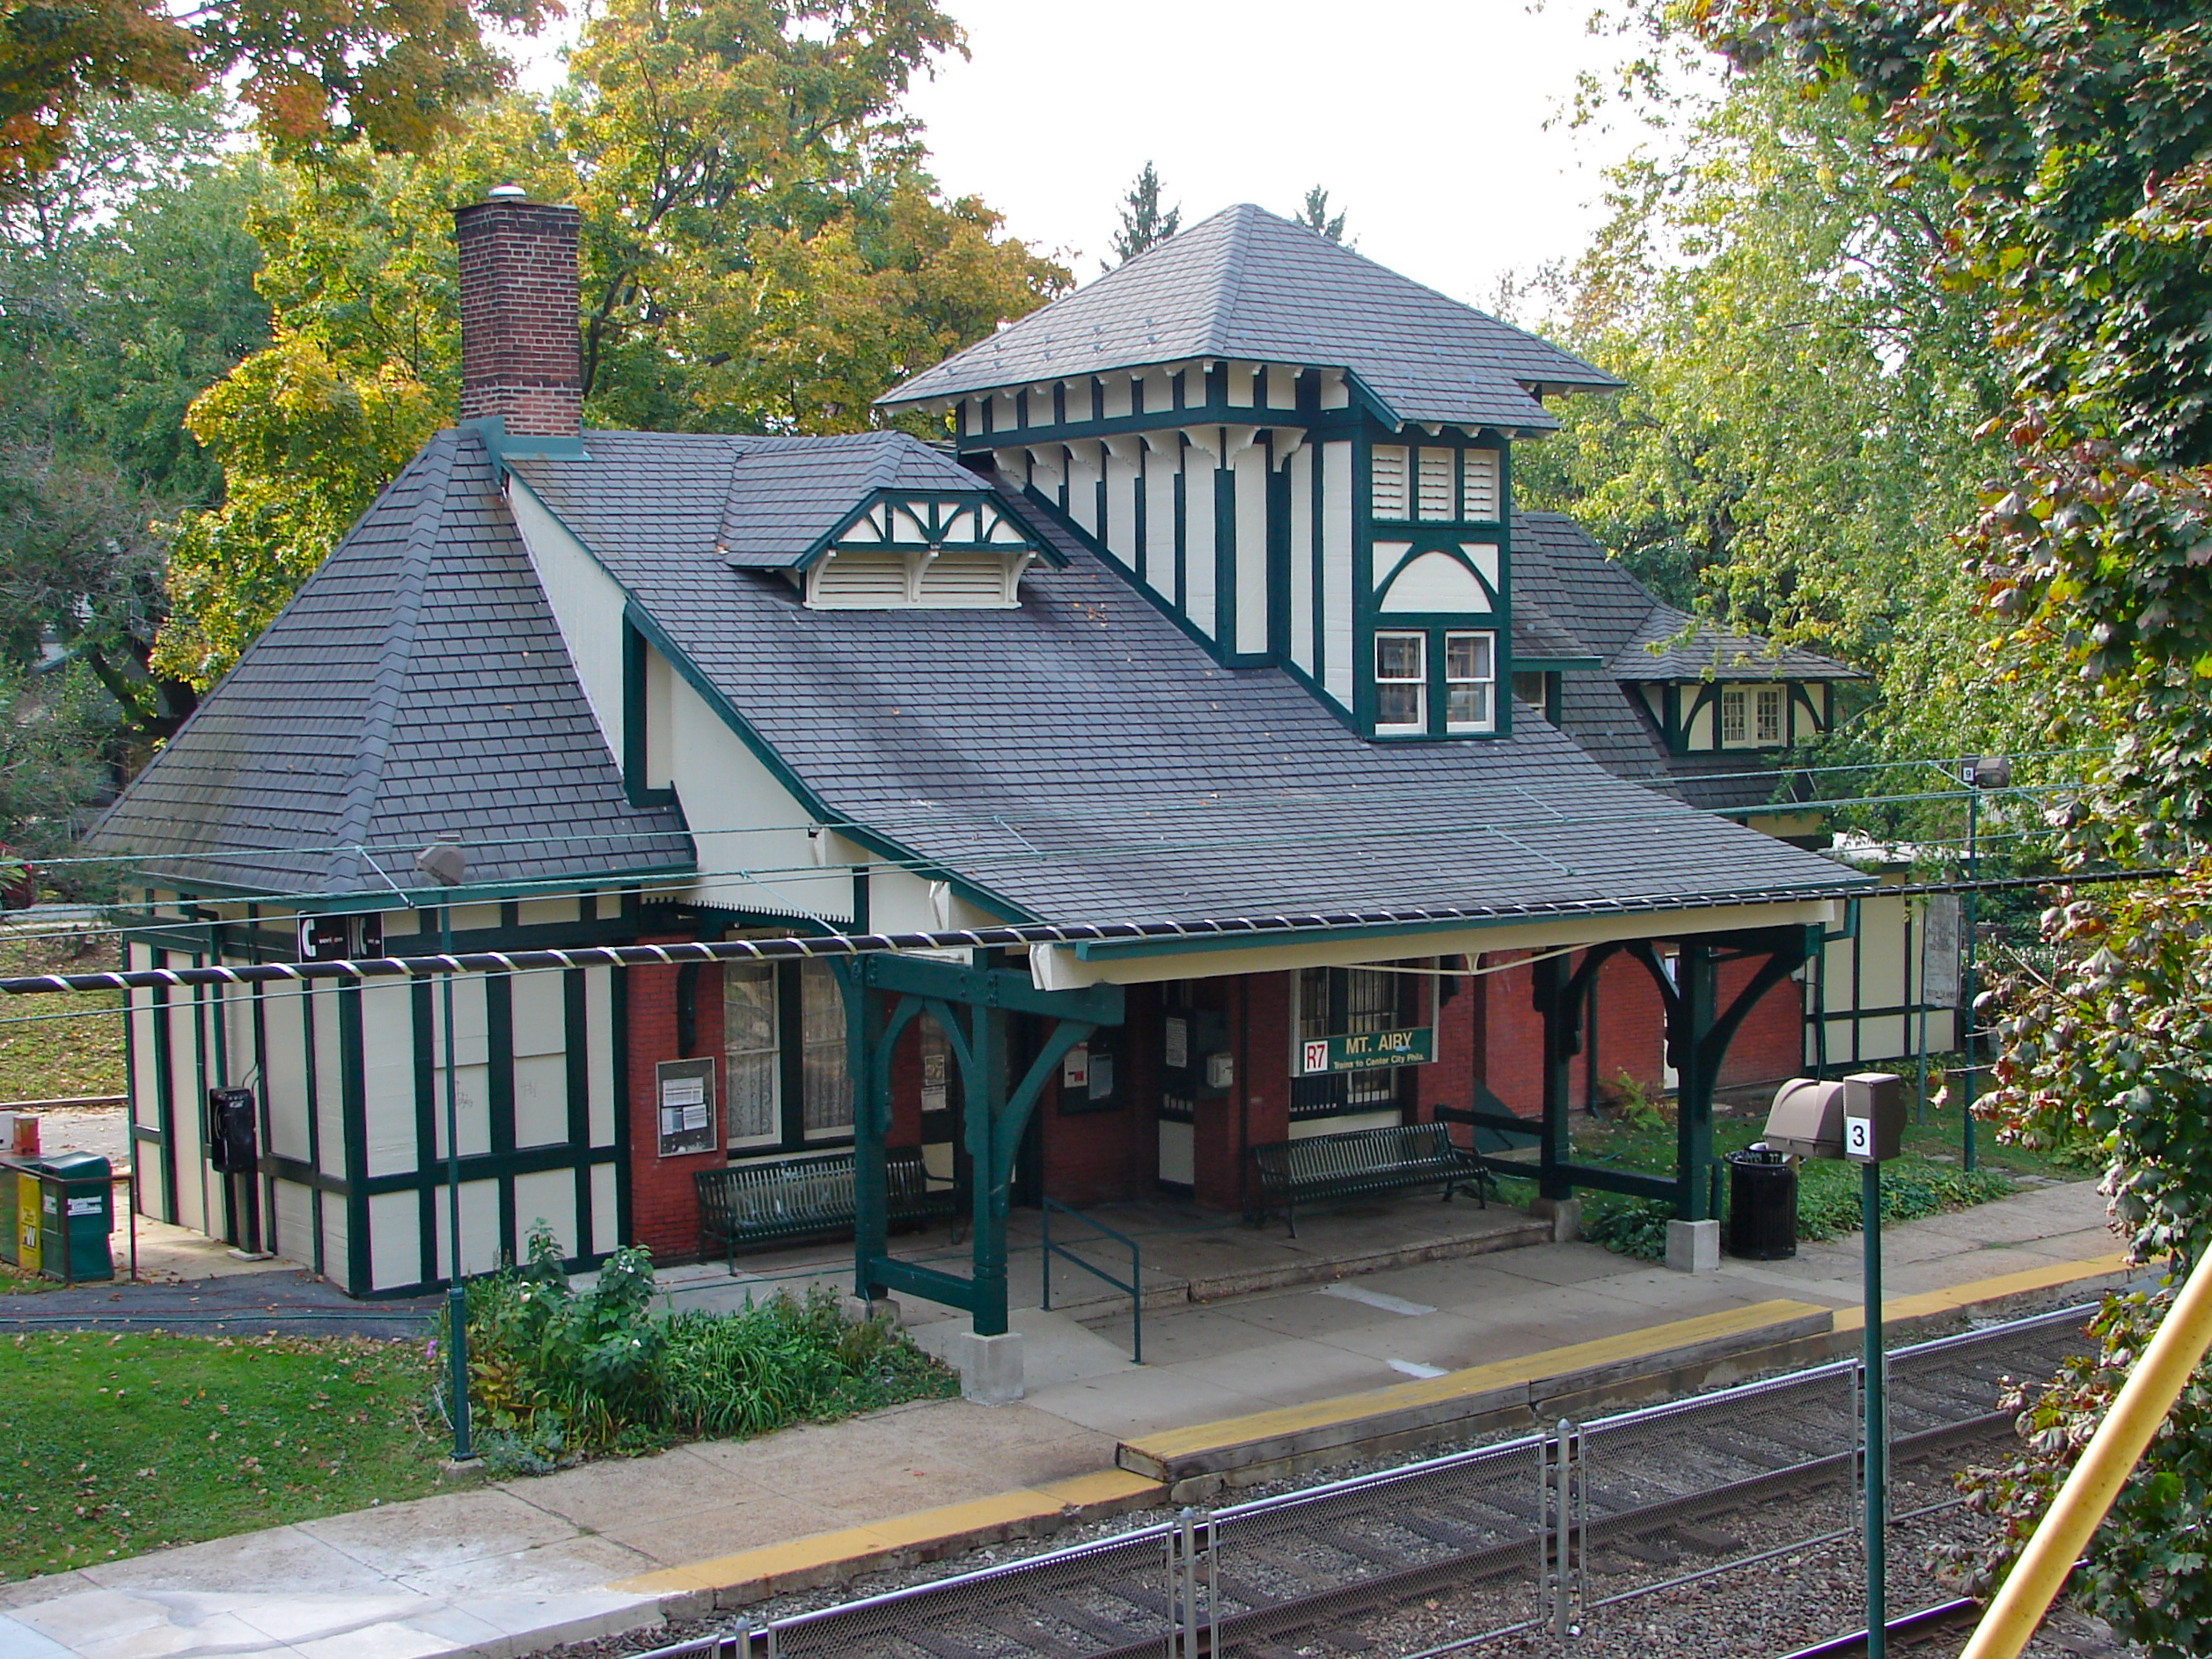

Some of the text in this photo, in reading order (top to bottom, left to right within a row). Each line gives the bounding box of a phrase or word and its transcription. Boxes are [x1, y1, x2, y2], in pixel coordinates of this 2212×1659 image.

[1345, 1031, 1412, 1054] MT. AIRY
[1307, 1044, 1325, 1069] R7
[1333, 1061, 1354, 1069] Trains
[1366, 1057, 1388, 1066] Center
[1390, 1054, 1405, 1064] City
[1852, 1125, 1865, 1147] 3
